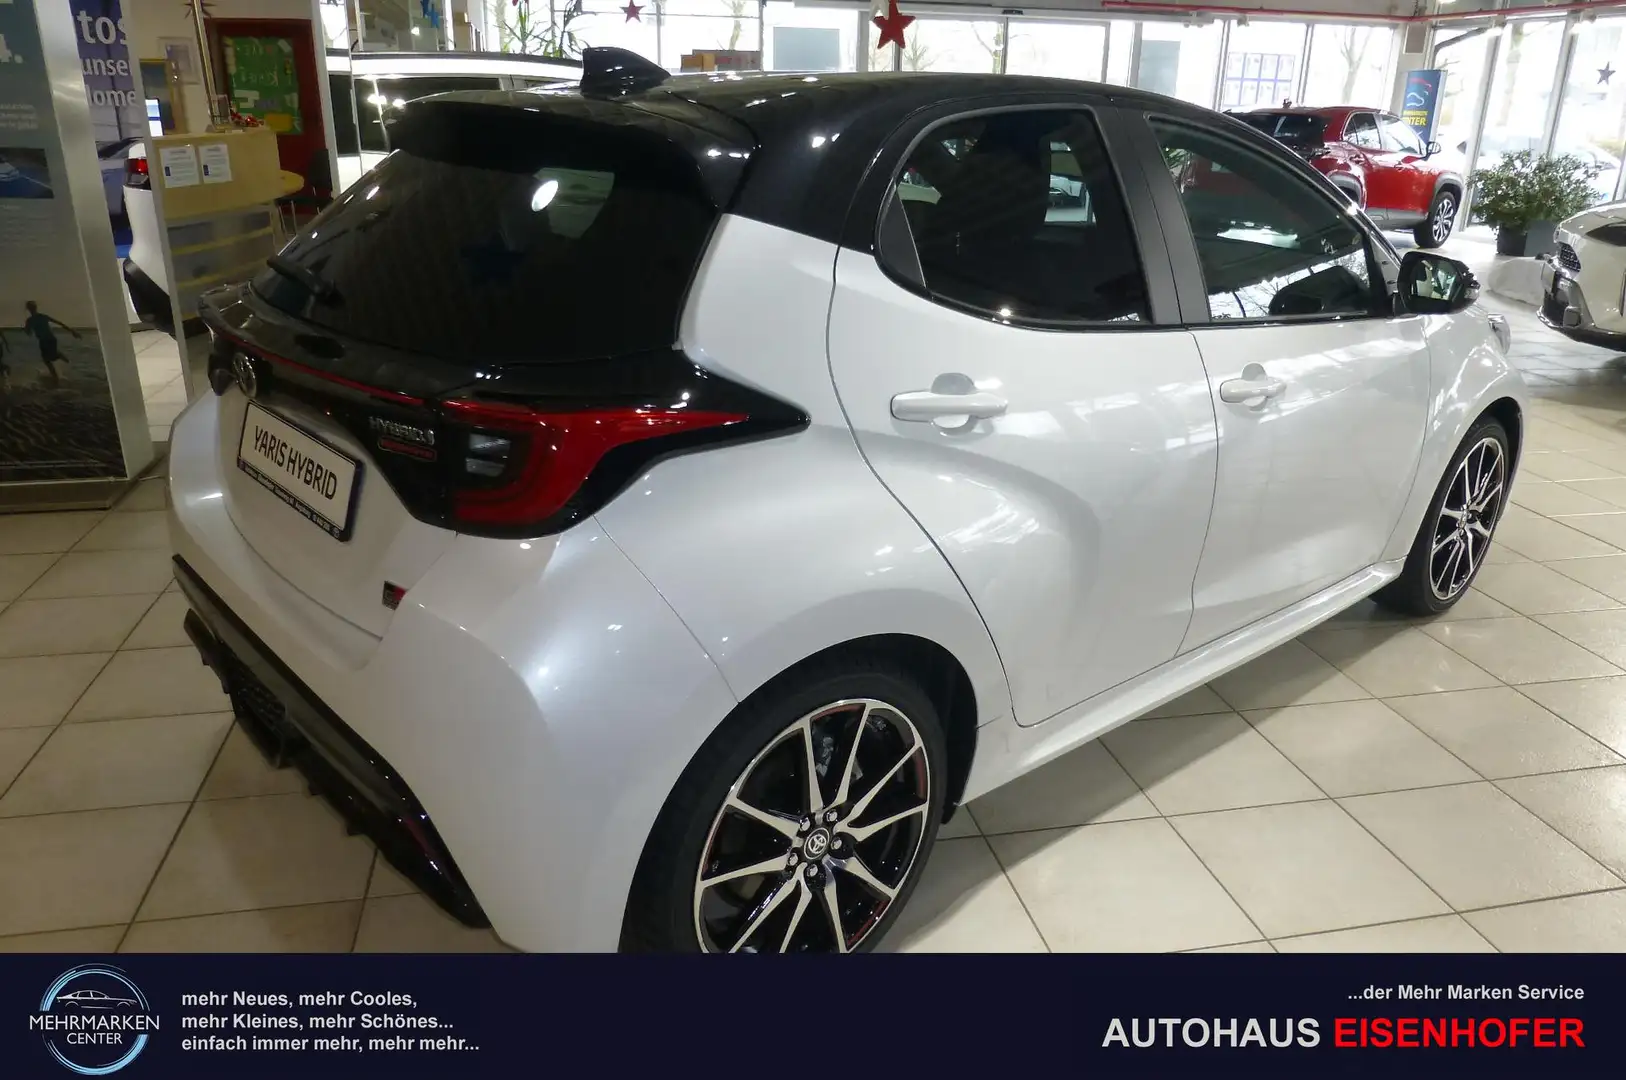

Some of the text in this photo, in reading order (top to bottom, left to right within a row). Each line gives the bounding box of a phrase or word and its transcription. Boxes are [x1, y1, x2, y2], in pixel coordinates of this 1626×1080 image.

[80, 58, 132, 77] unse
[255, 426, 288, 468] YARIS
[287, 447, 338, 500] HYBRID
